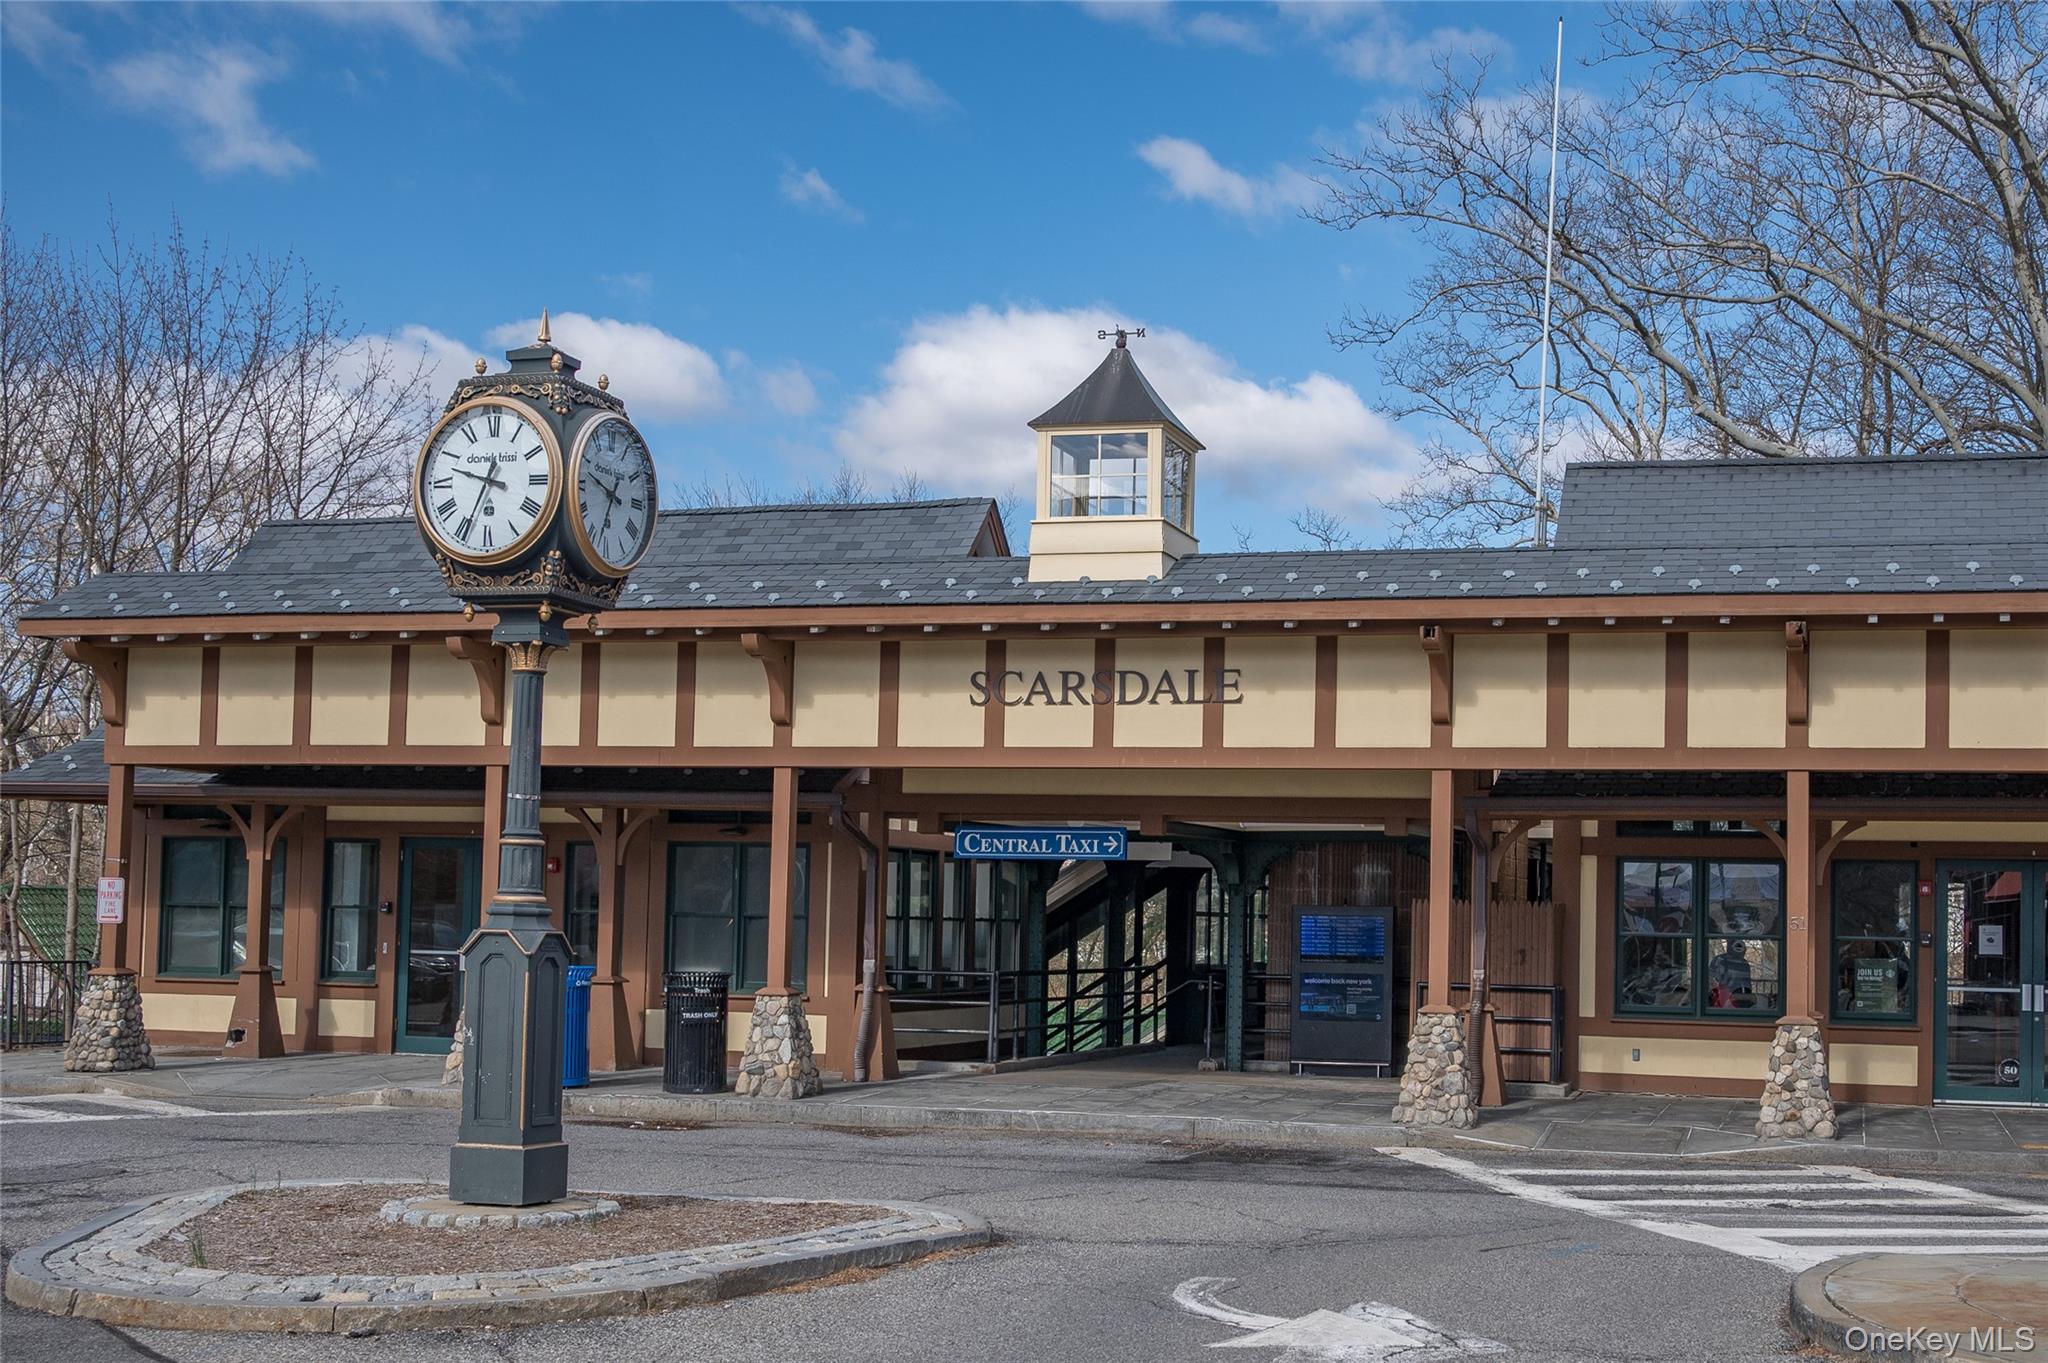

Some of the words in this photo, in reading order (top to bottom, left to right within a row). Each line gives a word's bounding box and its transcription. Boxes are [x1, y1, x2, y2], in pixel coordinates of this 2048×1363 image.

[969, 669, 1244, 706] SCARSDALE
[964, 833, 1053, 853] CENTRAL
[1056, 834, 1099, 854] TAXI
[107, 881, 115, 889] NO
[99, 891, 121, 899] PARKING
[1857, 968, 1872, 976] JOIN
[1873, 968, 1883, 976] US
[1304, 977, 1330, 985] welcome
[1331, 977, 1346, 985] back
[1359, 978, 1372, 986] york
[2003, 1066, 2018, 1075] 50
